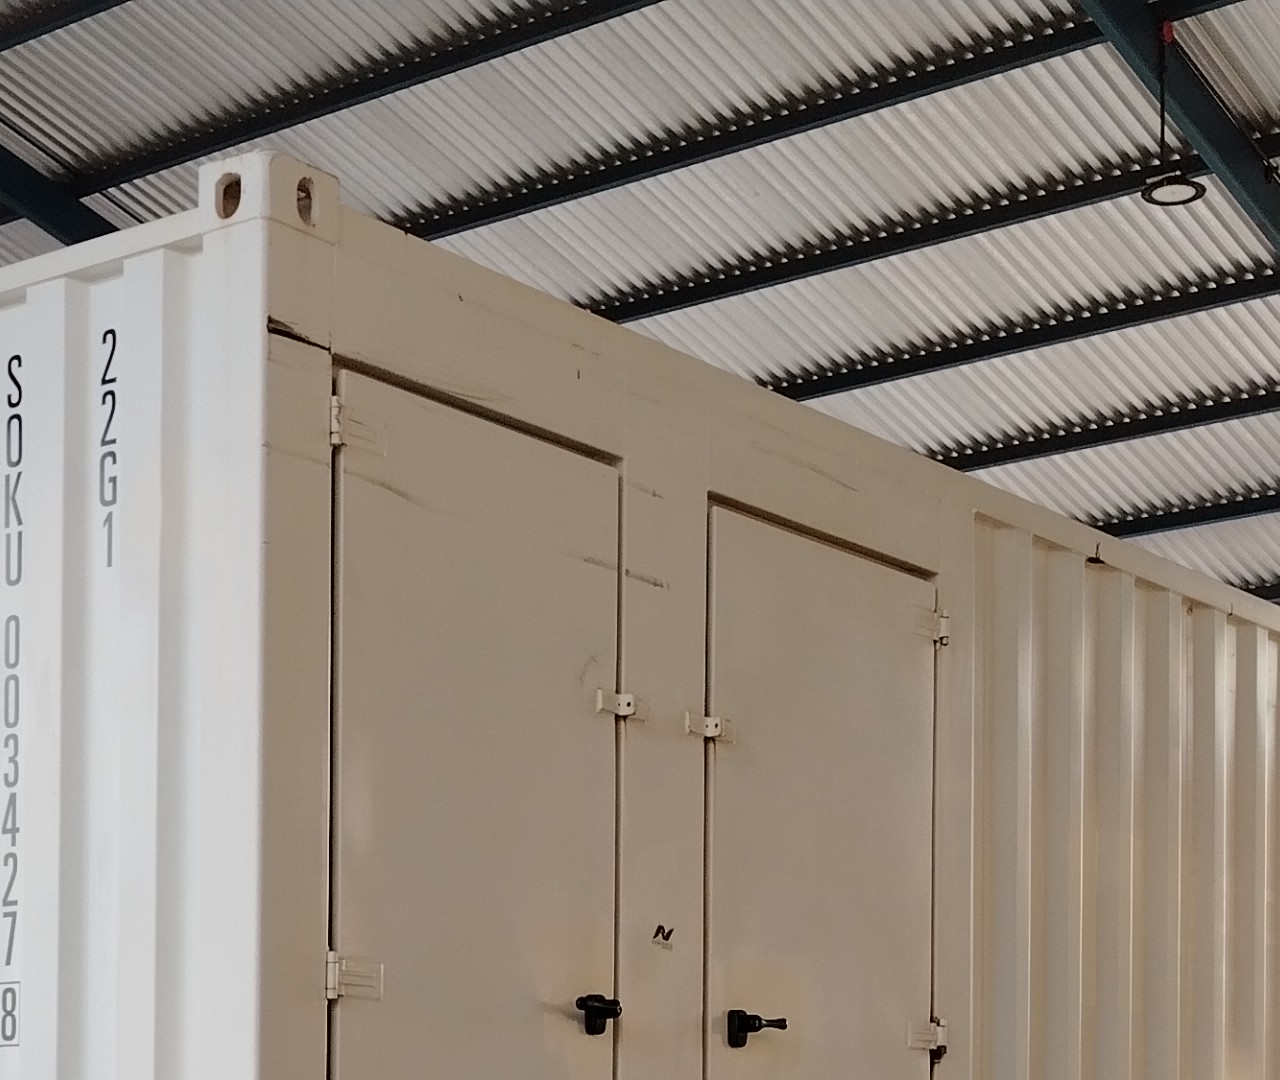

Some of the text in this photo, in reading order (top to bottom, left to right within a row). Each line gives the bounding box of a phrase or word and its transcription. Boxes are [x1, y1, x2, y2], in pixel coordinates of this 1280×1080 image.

[98, 328, 118, 568] 22G1
[0, 354, 23, 1042] SOKU 003427 8
